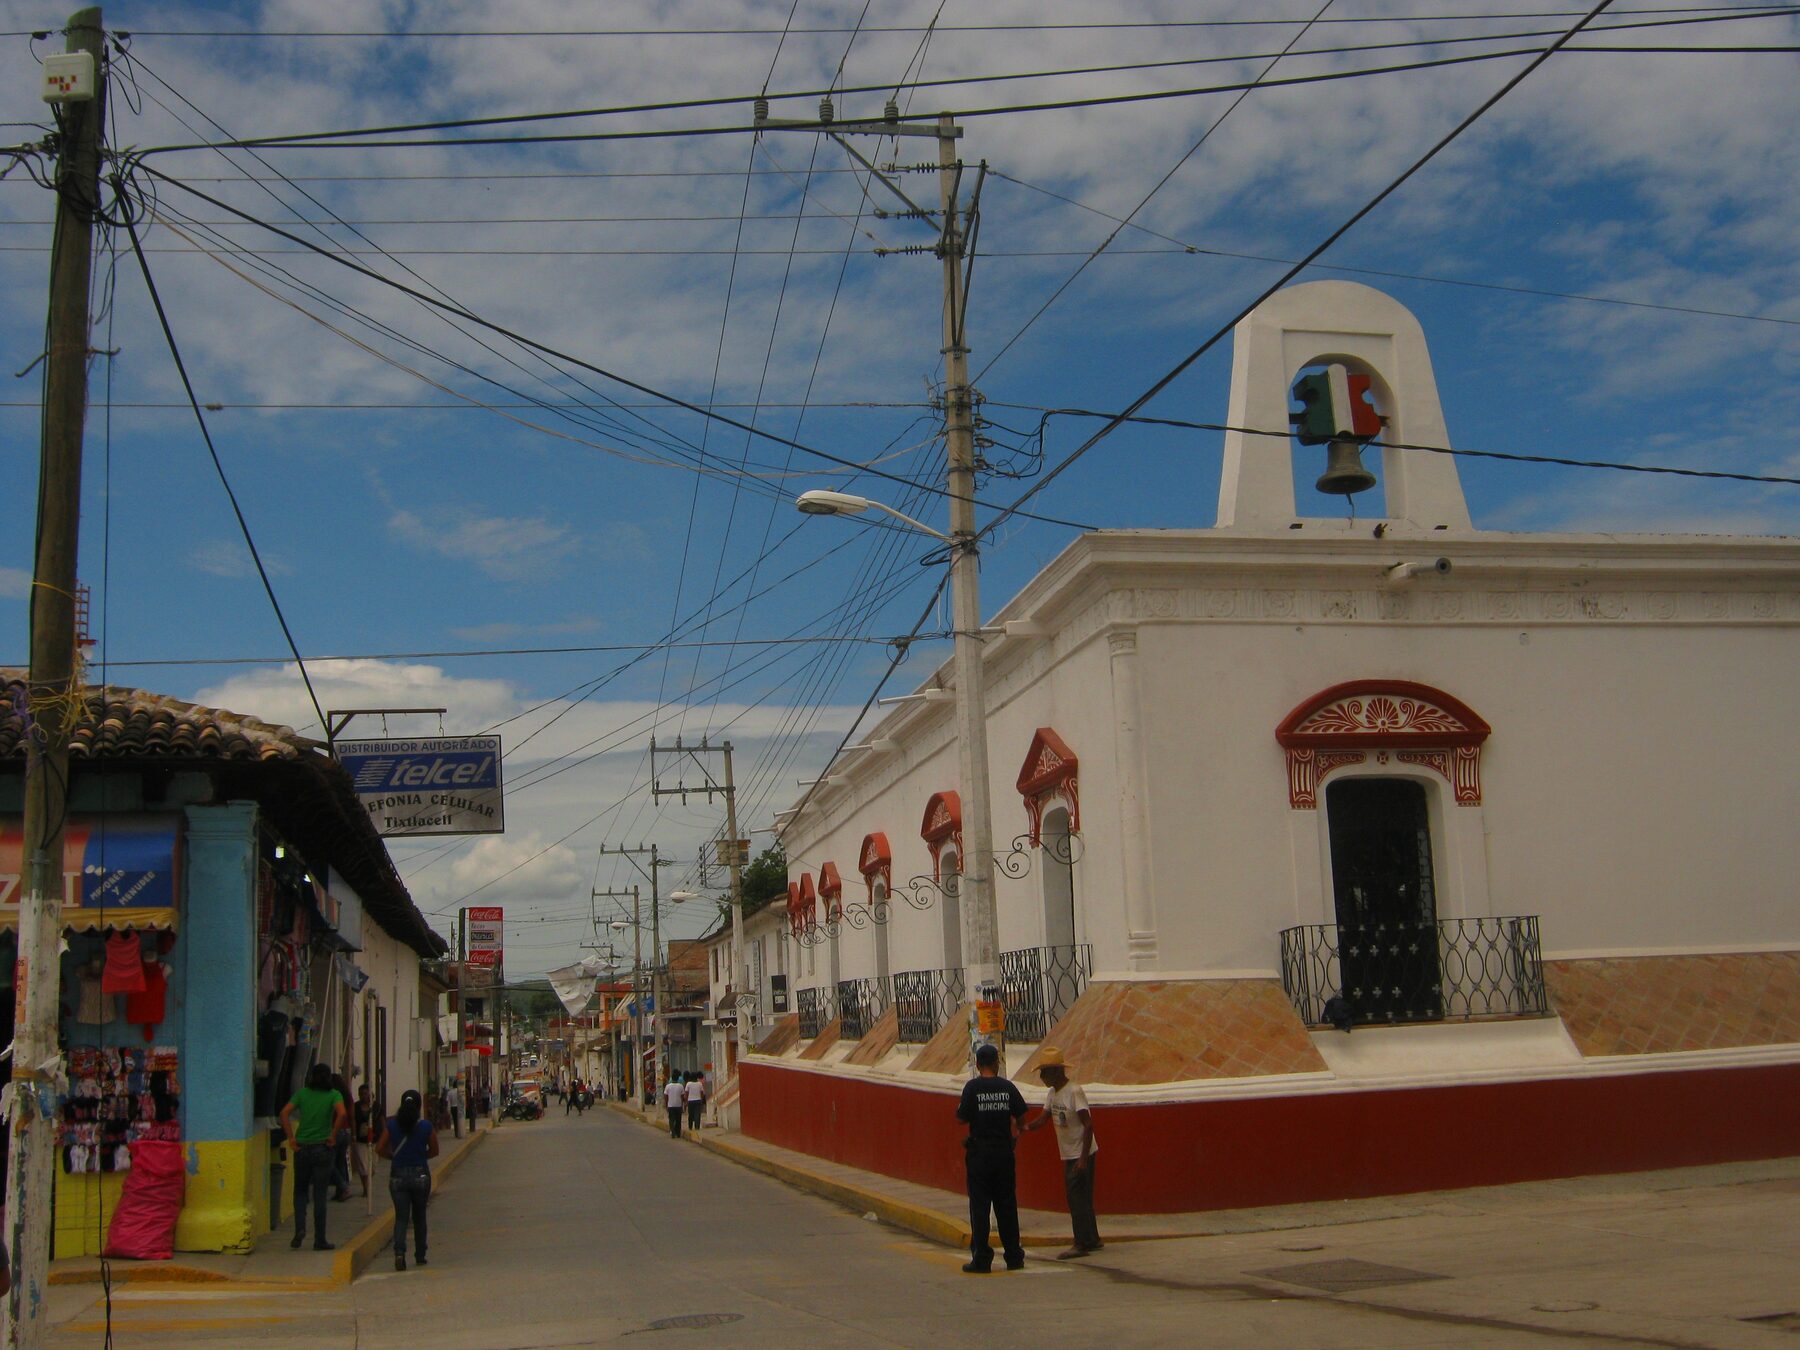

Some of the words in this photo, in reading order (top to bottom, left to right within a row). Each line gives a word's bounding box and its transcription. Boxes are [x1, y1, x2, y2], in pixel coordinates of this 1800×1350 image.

[339, 740, 418, 754] DISTRIBUIDOR
[421, 739, 497, 752] AUTORIZADO
[388, 756, 493, 787] telcel
[368, 794, 422, 814] EFONIA
[430, 794, 494, 818] CELULAR
[384, 814, 452, 828] Tixtlacell
[976, 1092, 1010, 1102] TRANSITO
